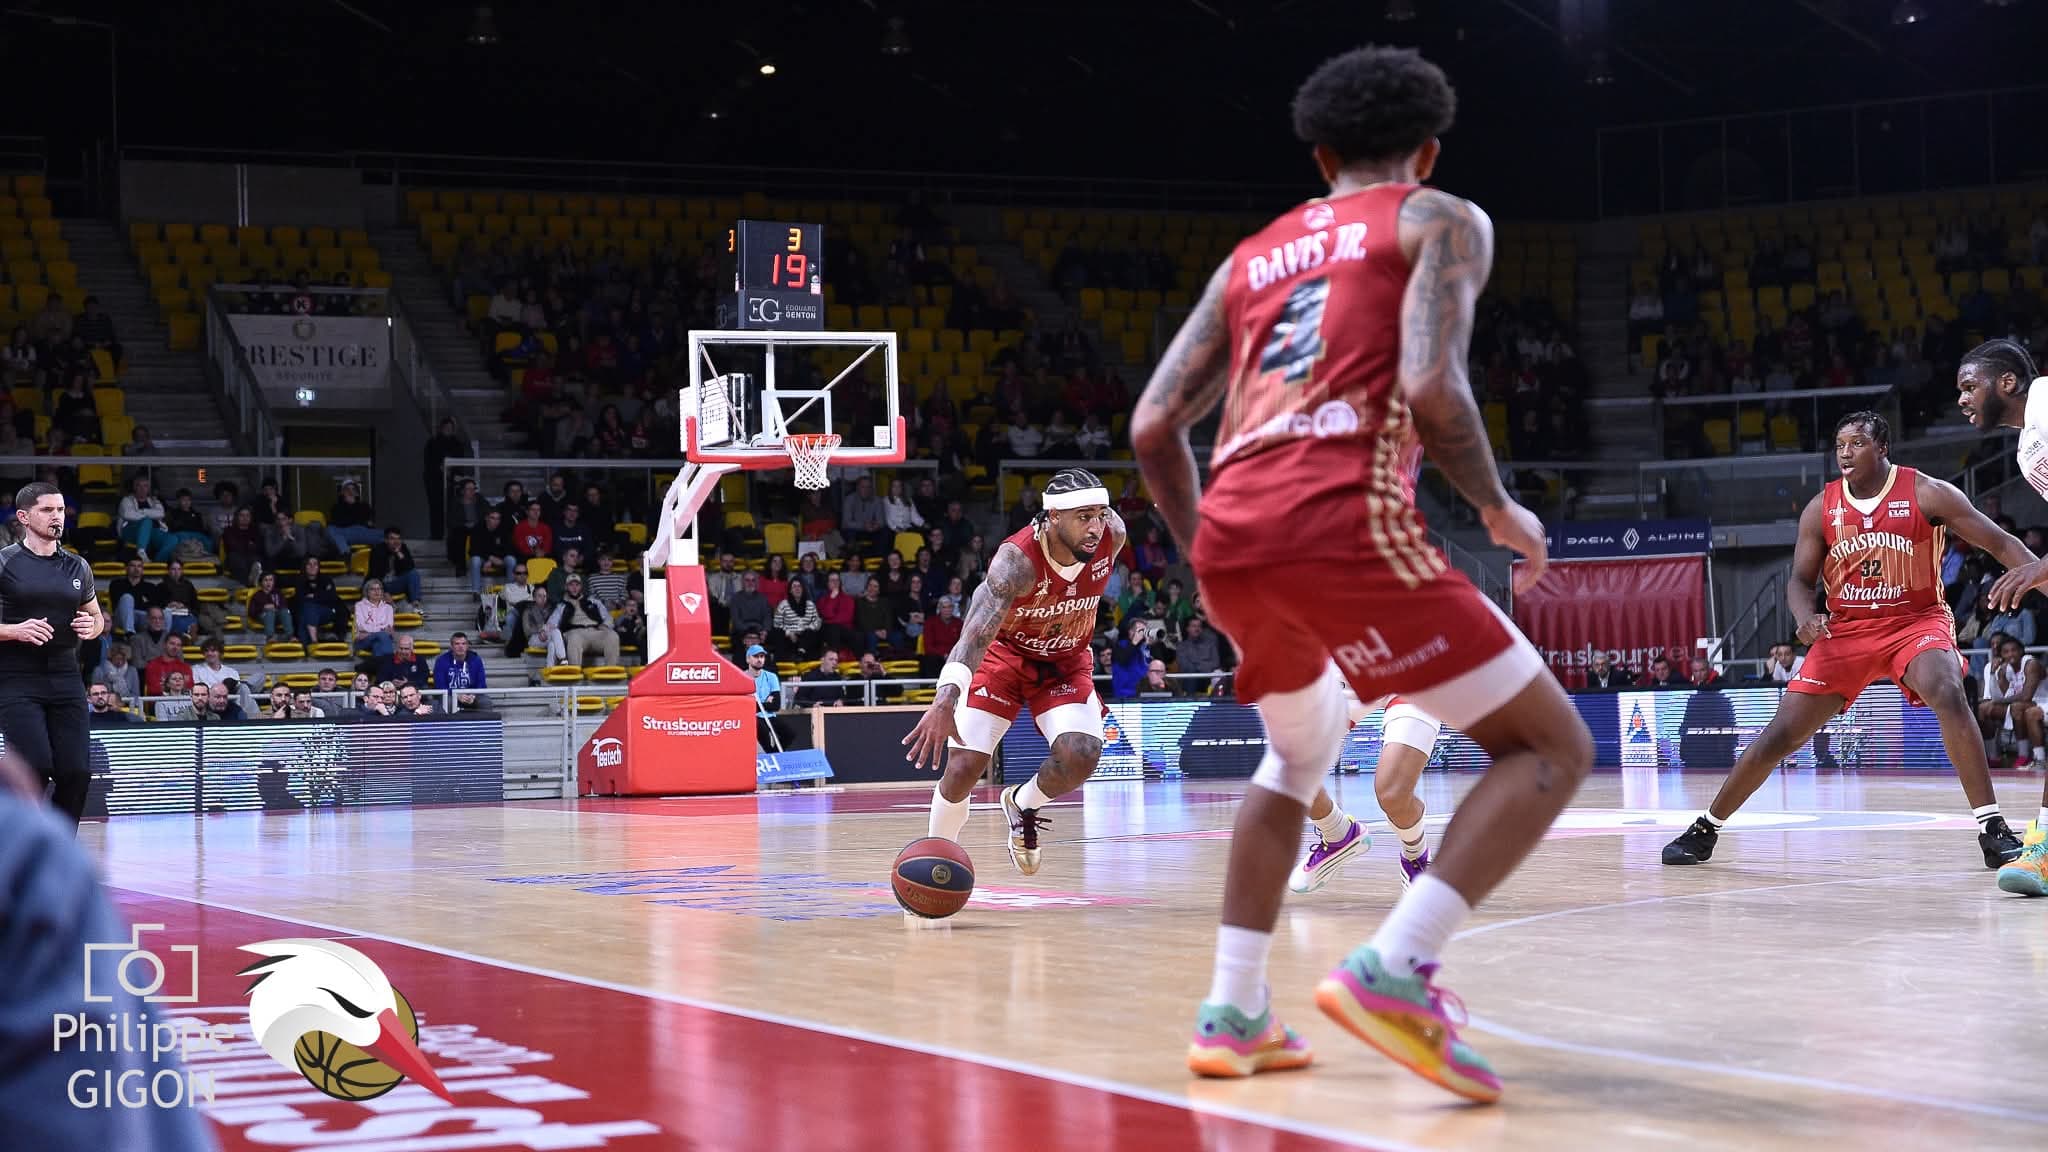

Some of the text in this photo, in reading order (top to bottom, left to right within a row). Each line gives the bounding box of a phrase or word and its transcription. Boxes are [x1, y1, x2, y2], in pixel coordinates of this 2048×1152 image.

[787, 227, 802, 252] 3
[1247, 222, 1368, 291] DAVIS JR.
[772, 253, 807, 288] 19
[749, 297, 782, 322] EG
[785, 311, 817, 319] GENTON
[1259, 276, 1331, 385] 4
[240, 344, 377, 368] RESTIGE
[1567, 531, 1705, 545] DACIA ALPINE
[1830, 532, 1914, 562] STRASBOURG
[1861, 560, 1883, 577] 32
[1841, 582, 1904, 601] Stradim
[1335, 626, 1393, 678] RH
[671, 666, 717, 681] Betclic
[642, 716, 741, 737] Strasbourg.eu
